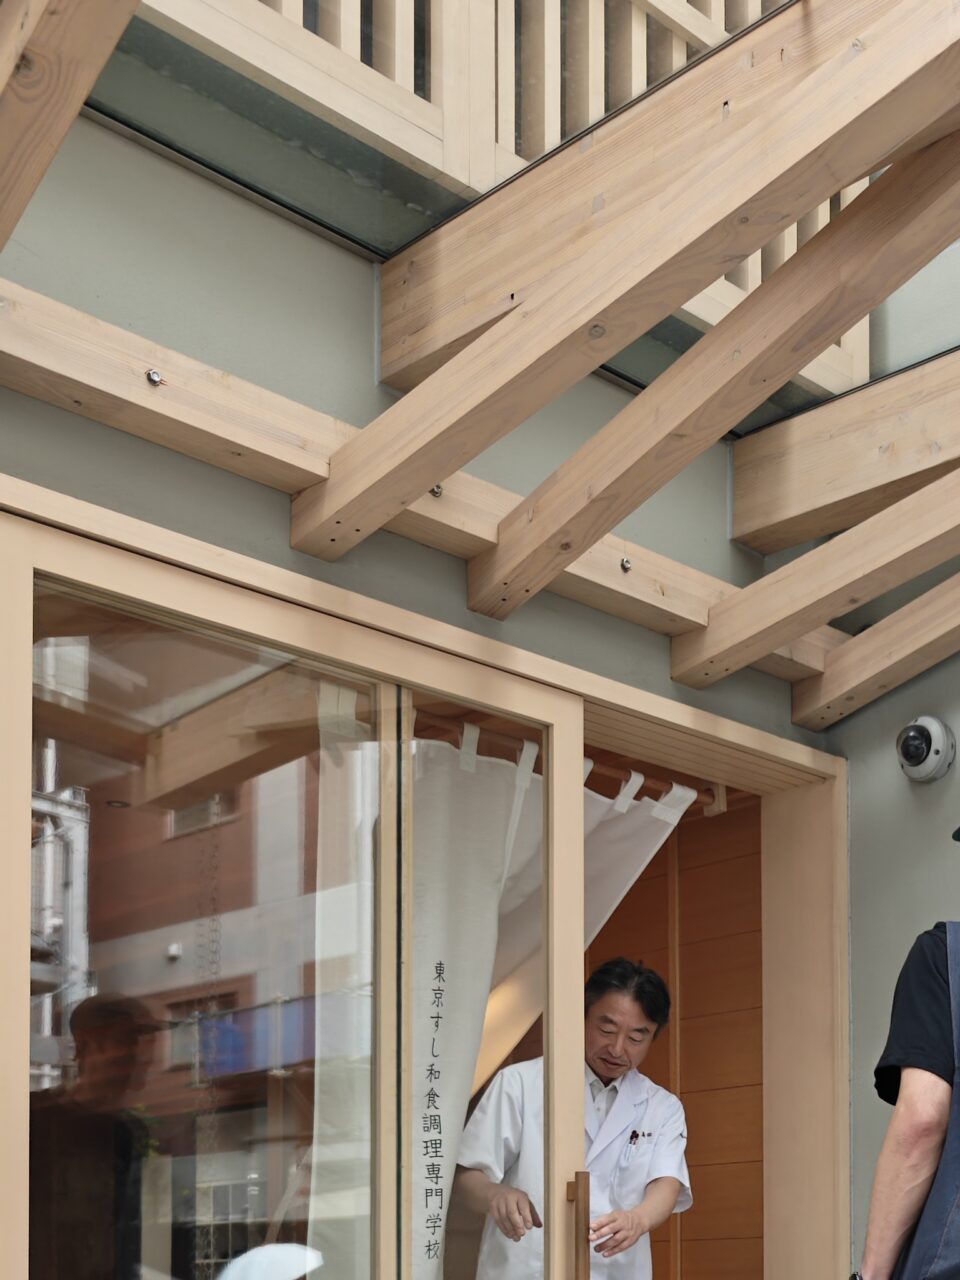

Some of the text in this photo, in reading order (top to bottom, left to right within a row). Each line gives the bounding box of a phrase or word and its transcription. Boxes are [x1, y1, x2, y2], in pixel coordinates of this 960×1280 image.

[422, 961, 446, 1260] 東京すし和食調理専門学校
